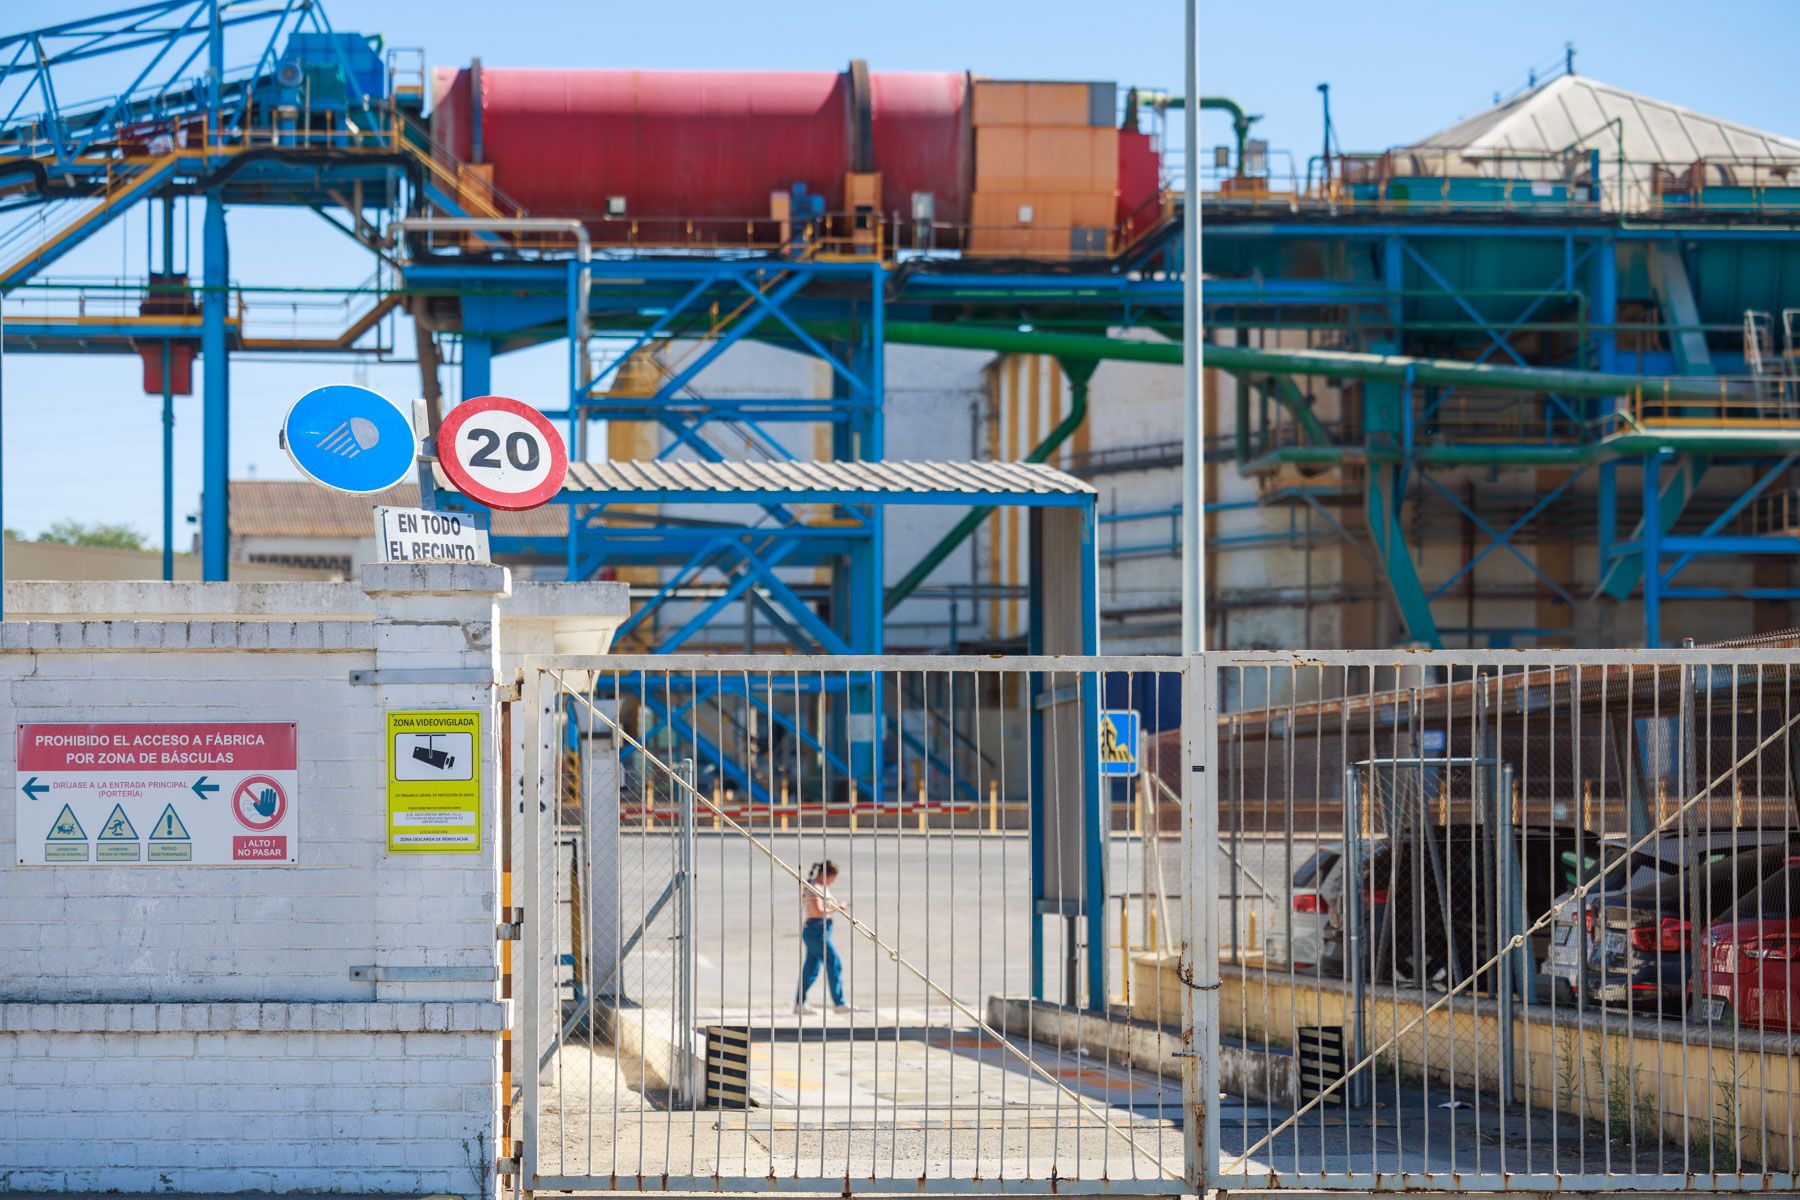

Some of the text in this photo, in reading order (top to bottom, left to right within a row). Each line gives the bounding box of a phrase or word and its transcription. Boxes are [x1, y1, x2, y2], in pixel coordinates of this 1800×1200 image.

[467, 428, 540, 471] 20
[398, 513, 461, 536] EN TODO
[389, 540, 475, 560] EL RECINTO
[393, 718, 474, 727] ZONA VIDEOVIGILADA
[35, 732, 266, 747] PROHIBIDO EL ACCESO A FÁBRICA
[66, 750, 234, 764] POR ZONA DE BÁSCULAS
[53, 780, 88, 789] DIRÍJASE
[97, 781, 107, 789] LA
[109, 781, 147, 789] ENTRADA
[148, 780, 189, 789] PRINCIPAL
[98, 789, 143, 798] (PORTERÍA)
[248, 839, 271, 847] ALTO
[237, 848, 282, 857] NO PASAR
